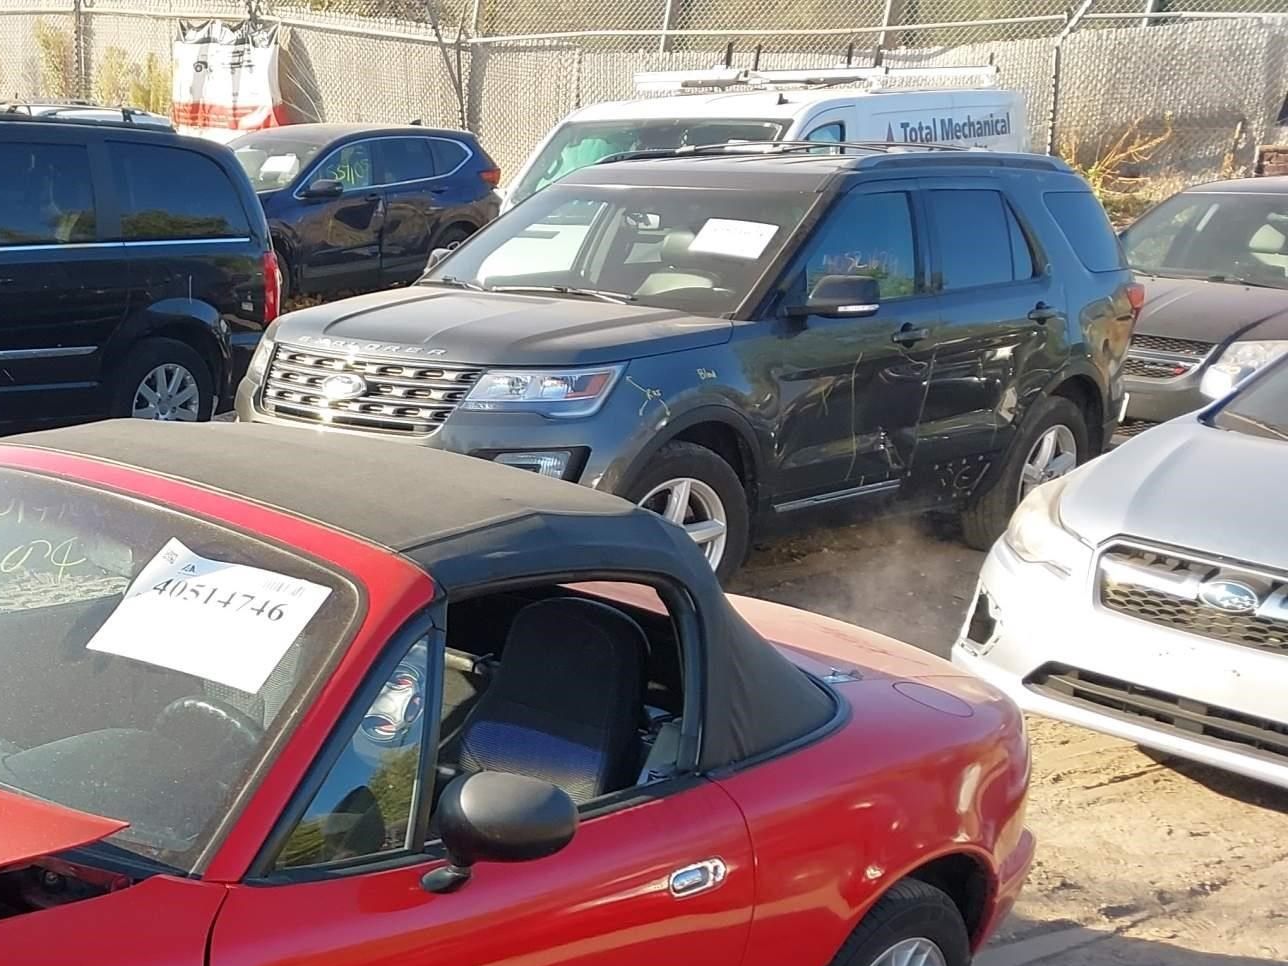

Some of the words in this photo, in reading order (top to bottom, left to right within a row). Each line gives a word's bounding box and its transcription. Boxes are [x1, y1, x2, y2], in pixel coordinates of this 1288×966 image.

[900, 117, 937, 143] Total
[940, 112, 1010, 141] Mechanical
[153, 578, 288, 621] 40514746
